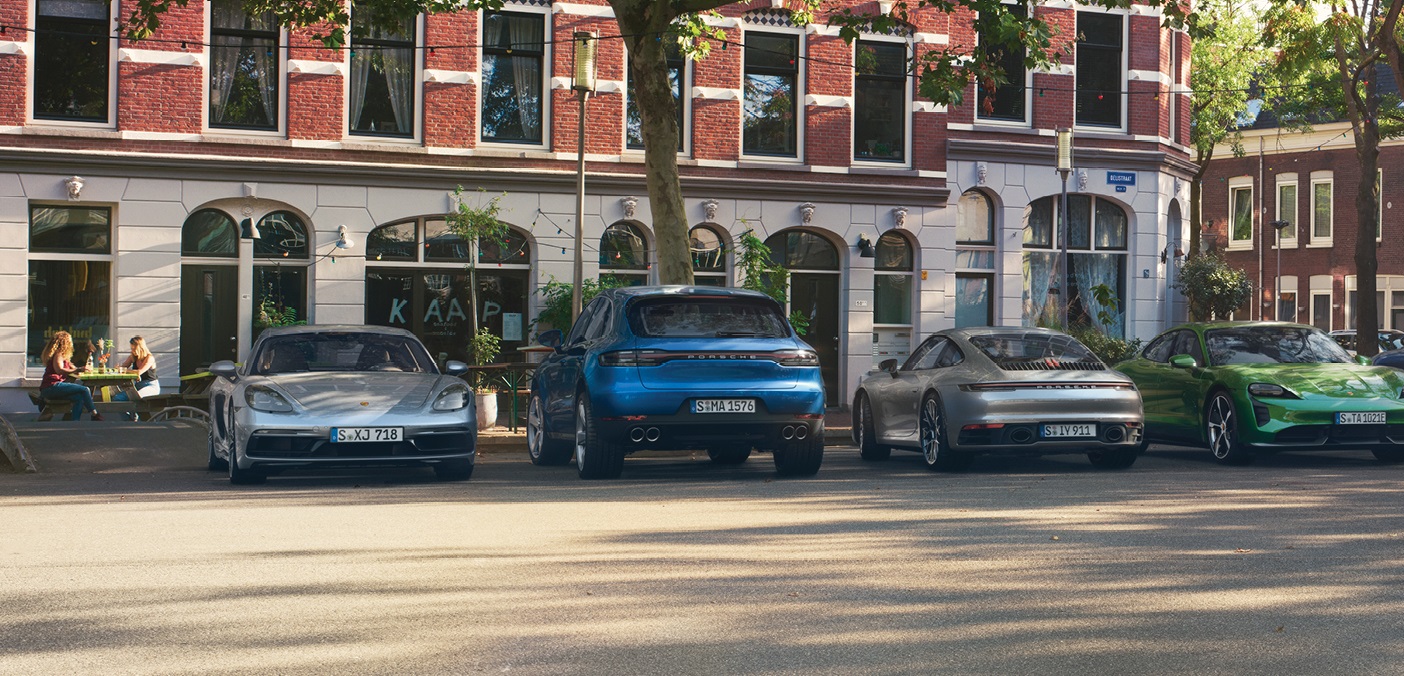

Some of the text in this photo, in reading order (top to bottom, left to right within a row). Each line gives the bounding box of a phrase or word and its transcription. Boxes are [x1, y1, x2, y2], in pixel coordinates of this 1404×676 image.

[389, 298, 500, 323] KAAP
[697, 401, 754, 411] S MA 1576
[1340, 413, 1386, 423] S TA 1021E
[338, 429, 346, 441] S
[354, 429, 370, 441] XJ
[375, 429, 398, 440] 718
[1045, 425, 1091, 436] S IY 911
